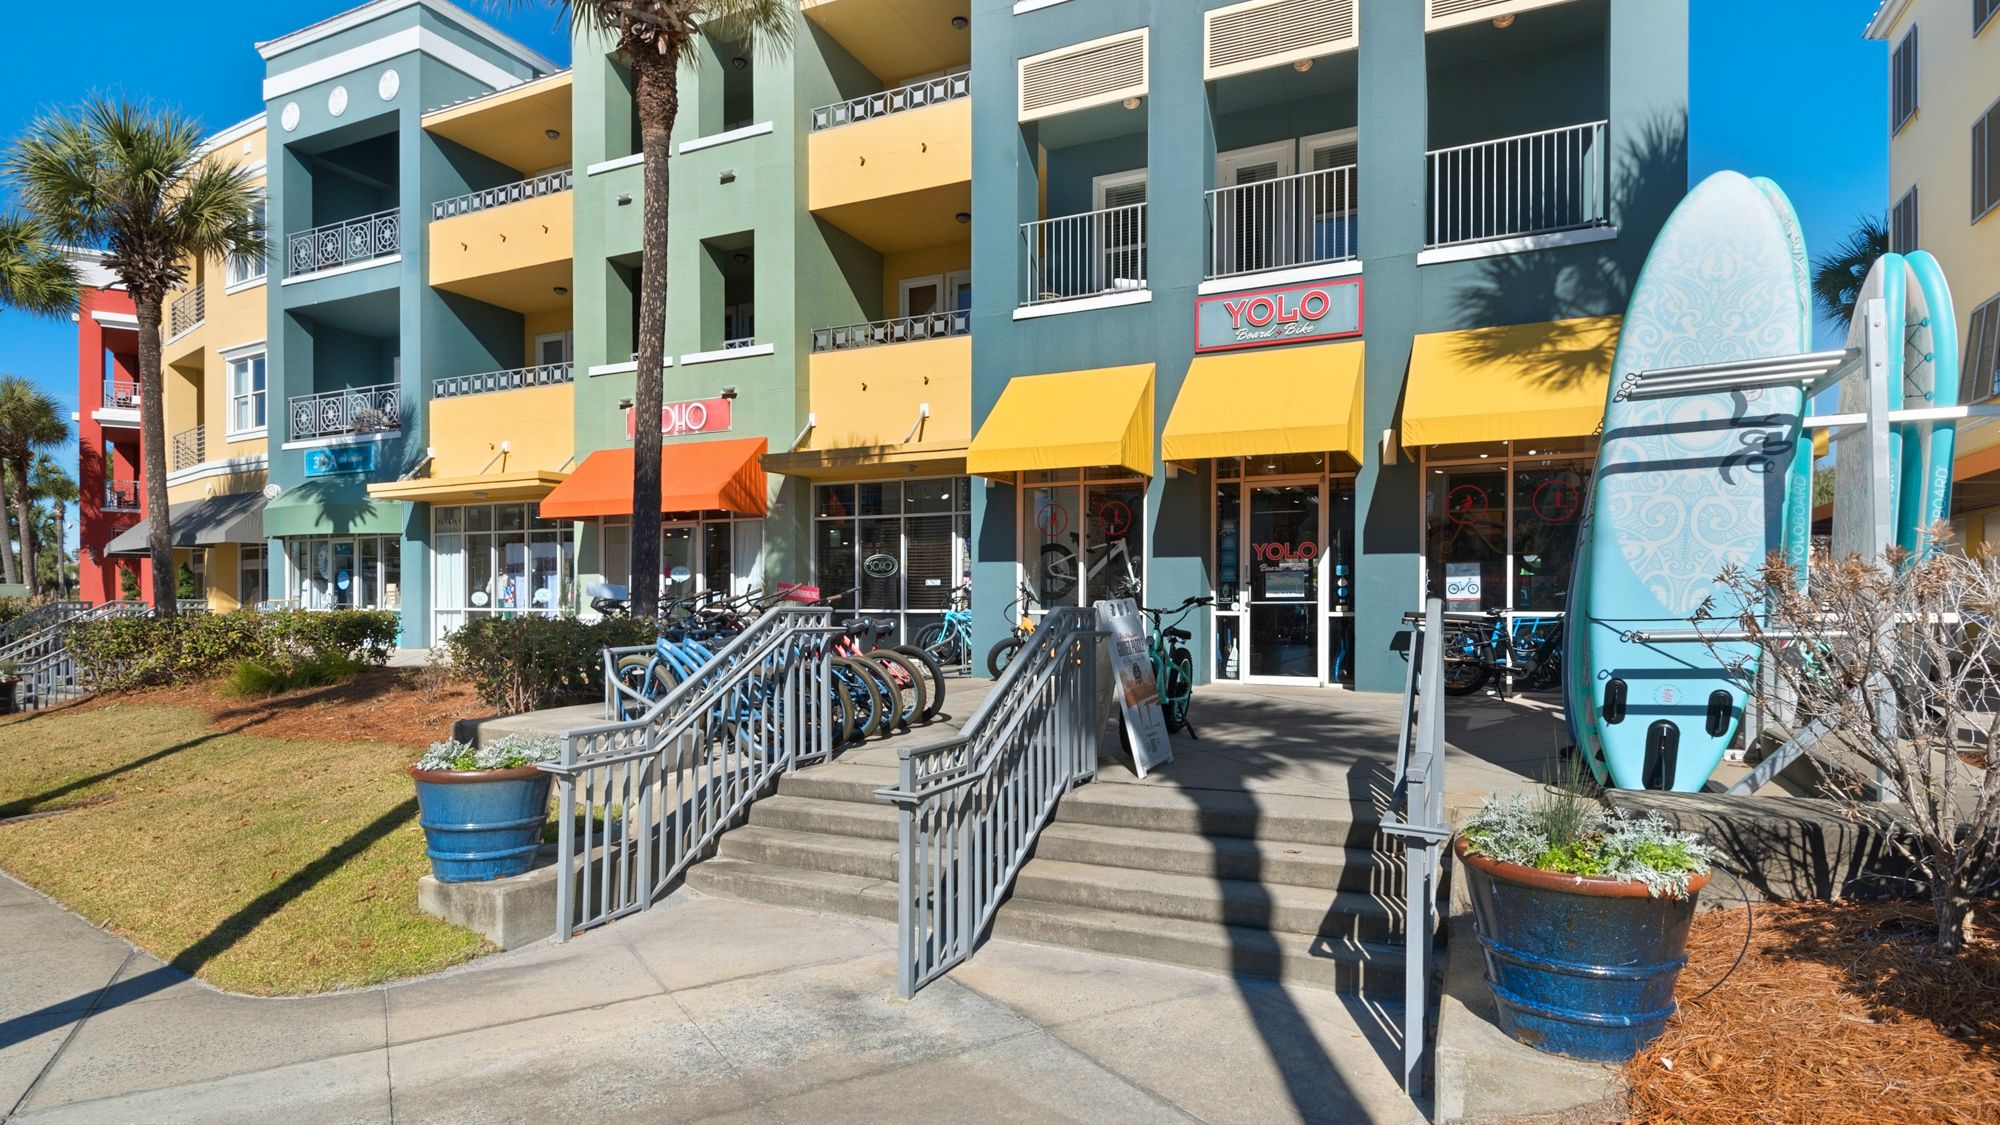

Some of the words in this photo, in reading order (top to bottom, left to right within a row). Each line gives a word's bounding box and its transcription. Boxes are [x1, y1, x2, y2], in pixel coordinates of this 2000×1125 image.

[1224, 290, 1331, 329] YOLO
[1236, 325, 1276, 341] Board
[1283, 322, 1316, 336] Bike
[662, 402, 707, 433] OHO
[1792, 475, 1806, 563] YOLOBOARD
[1252, 541, 1317, 561] YOLO
